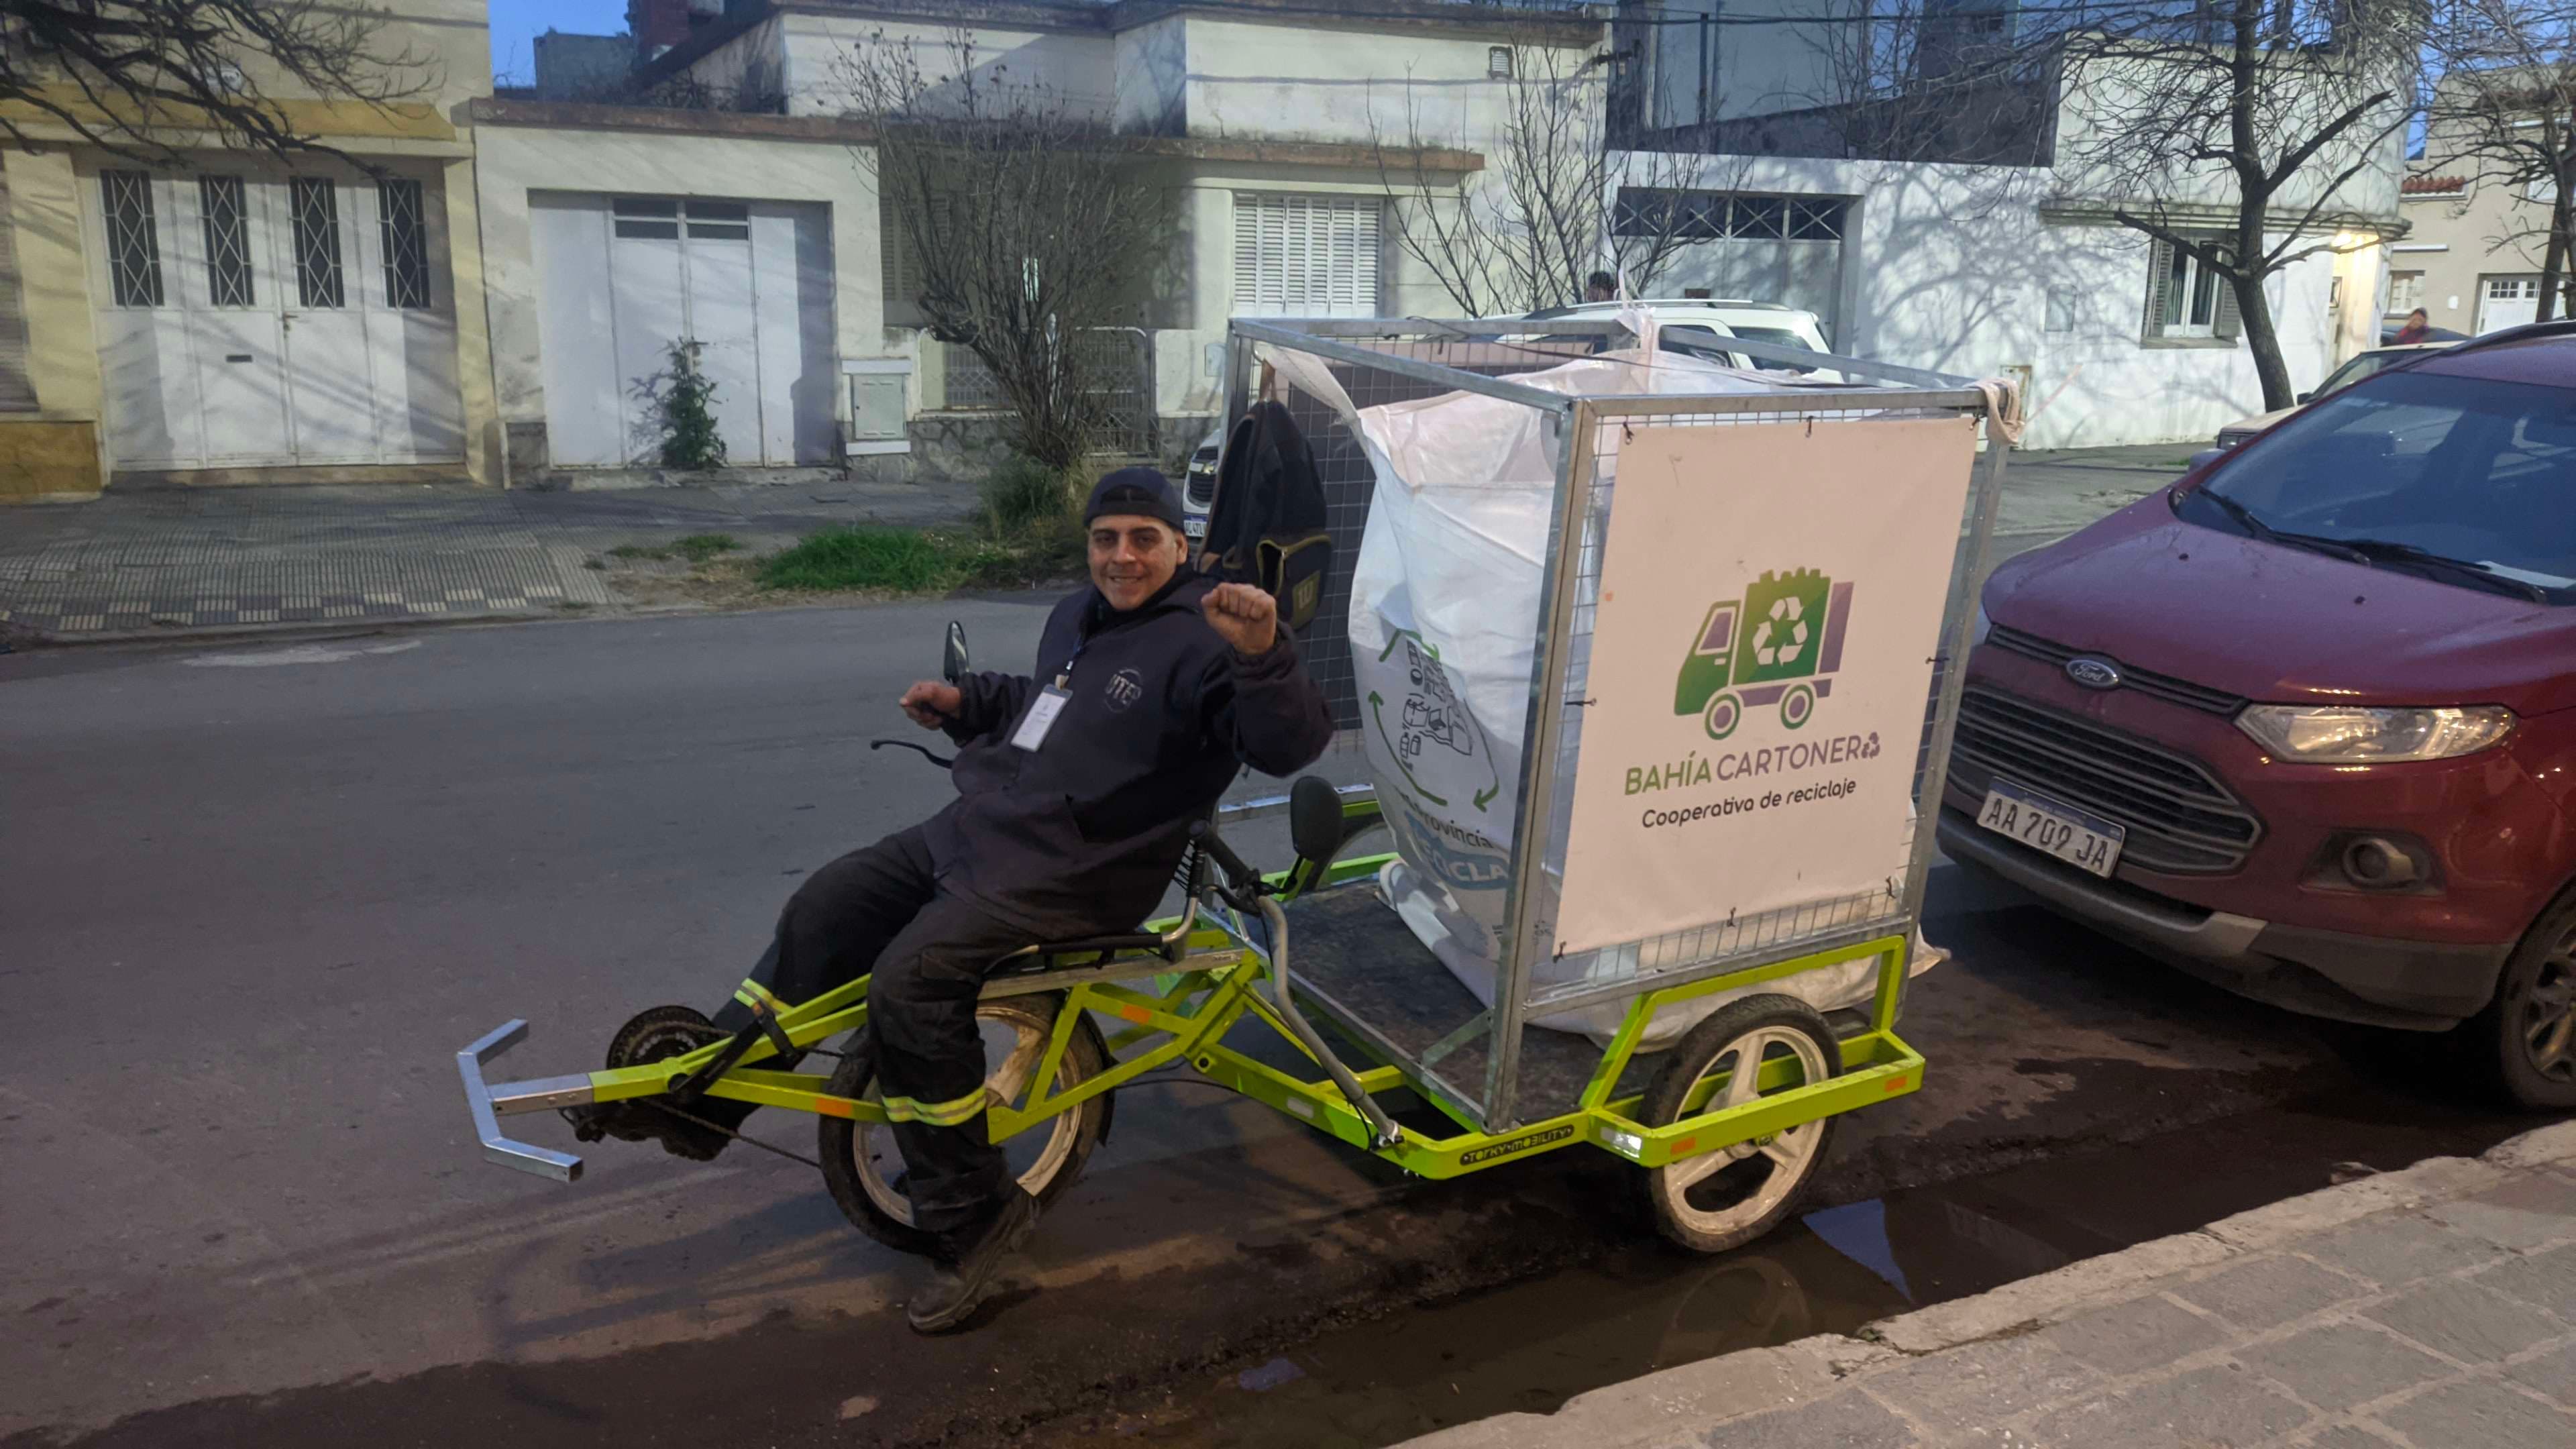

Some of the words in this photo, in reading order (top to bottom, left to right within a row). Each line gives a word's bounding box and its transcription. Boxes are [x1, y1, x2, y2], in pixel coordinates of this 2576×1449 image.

[2075, 664, 2106, 682] Ford
[1624, 749, 1712, 796] BAHÍA
[1642, 796, 1754, 828] Cooperativa
[1760, 790, 1782, 809] de
[1786, 777, 1857, 804] reciclaje
[1986, 798, 2019, 833] AA
[2023, 812, 2073, 851] 709
[2076, 833, 2108, 870] JA
